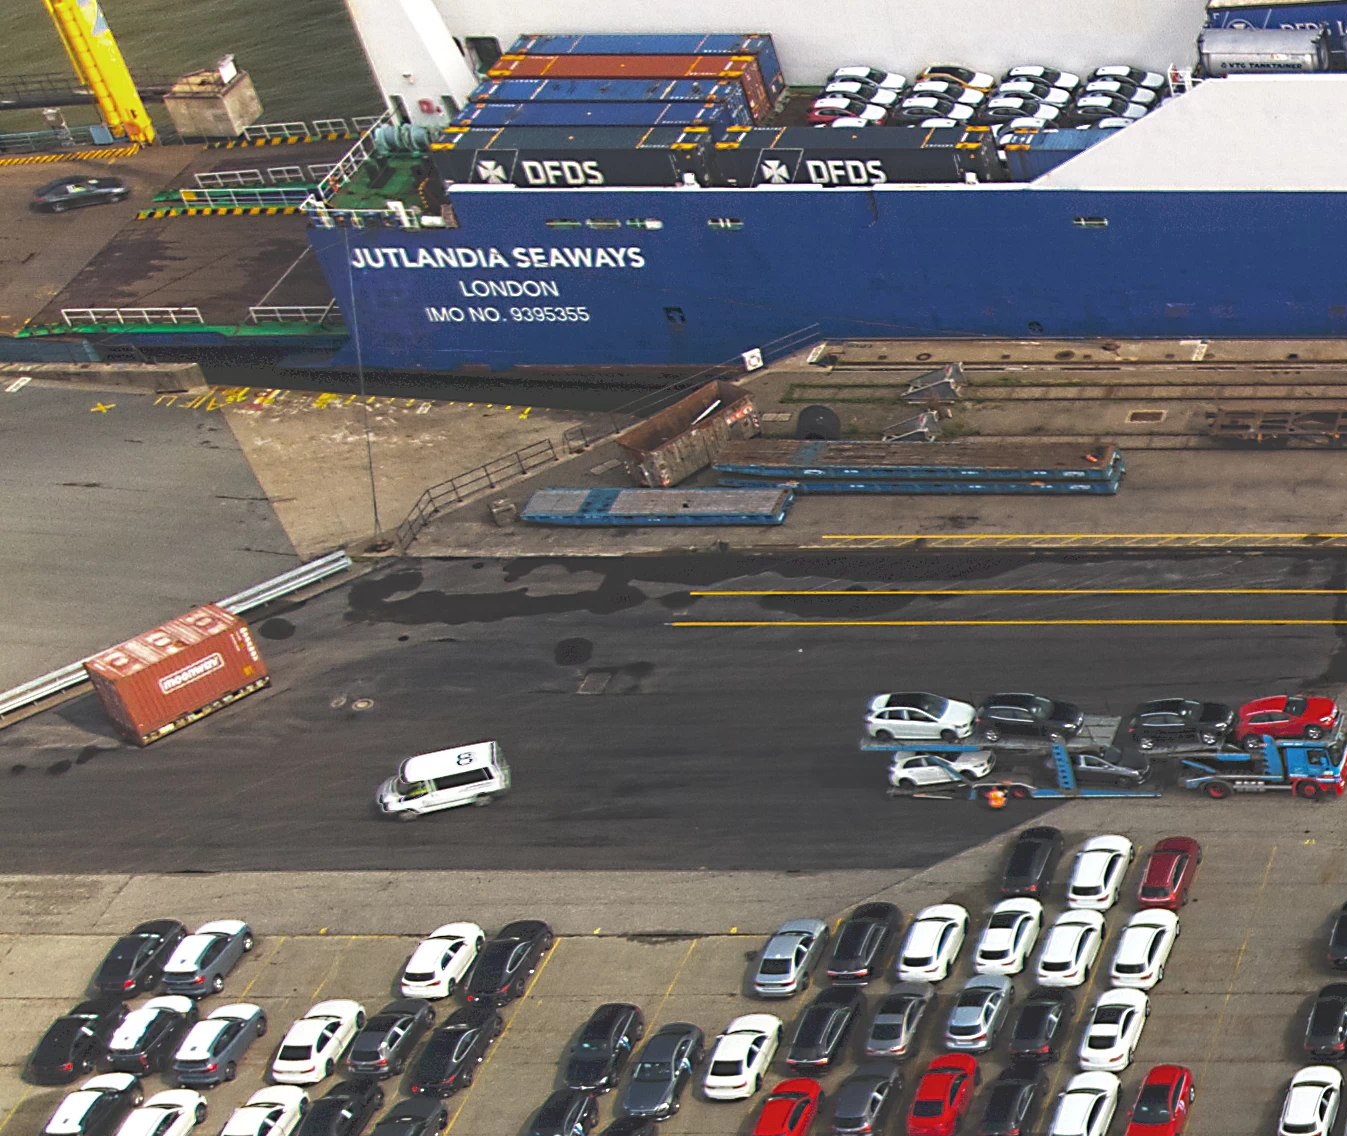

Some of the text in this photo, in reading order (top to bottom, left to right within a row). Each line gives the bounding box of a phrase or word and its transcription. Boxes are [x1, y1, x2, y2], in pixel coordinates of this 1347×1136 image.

[521, 160, 604, 186] DFDS
[806, 160, 886, 185] DFDS
[351, 246, 646, 269] JUTLANDIA SEAWAYS
[459, 280, 559, 298] LONDON
[425, 305, 590, 323] IMO NO. 9395355
